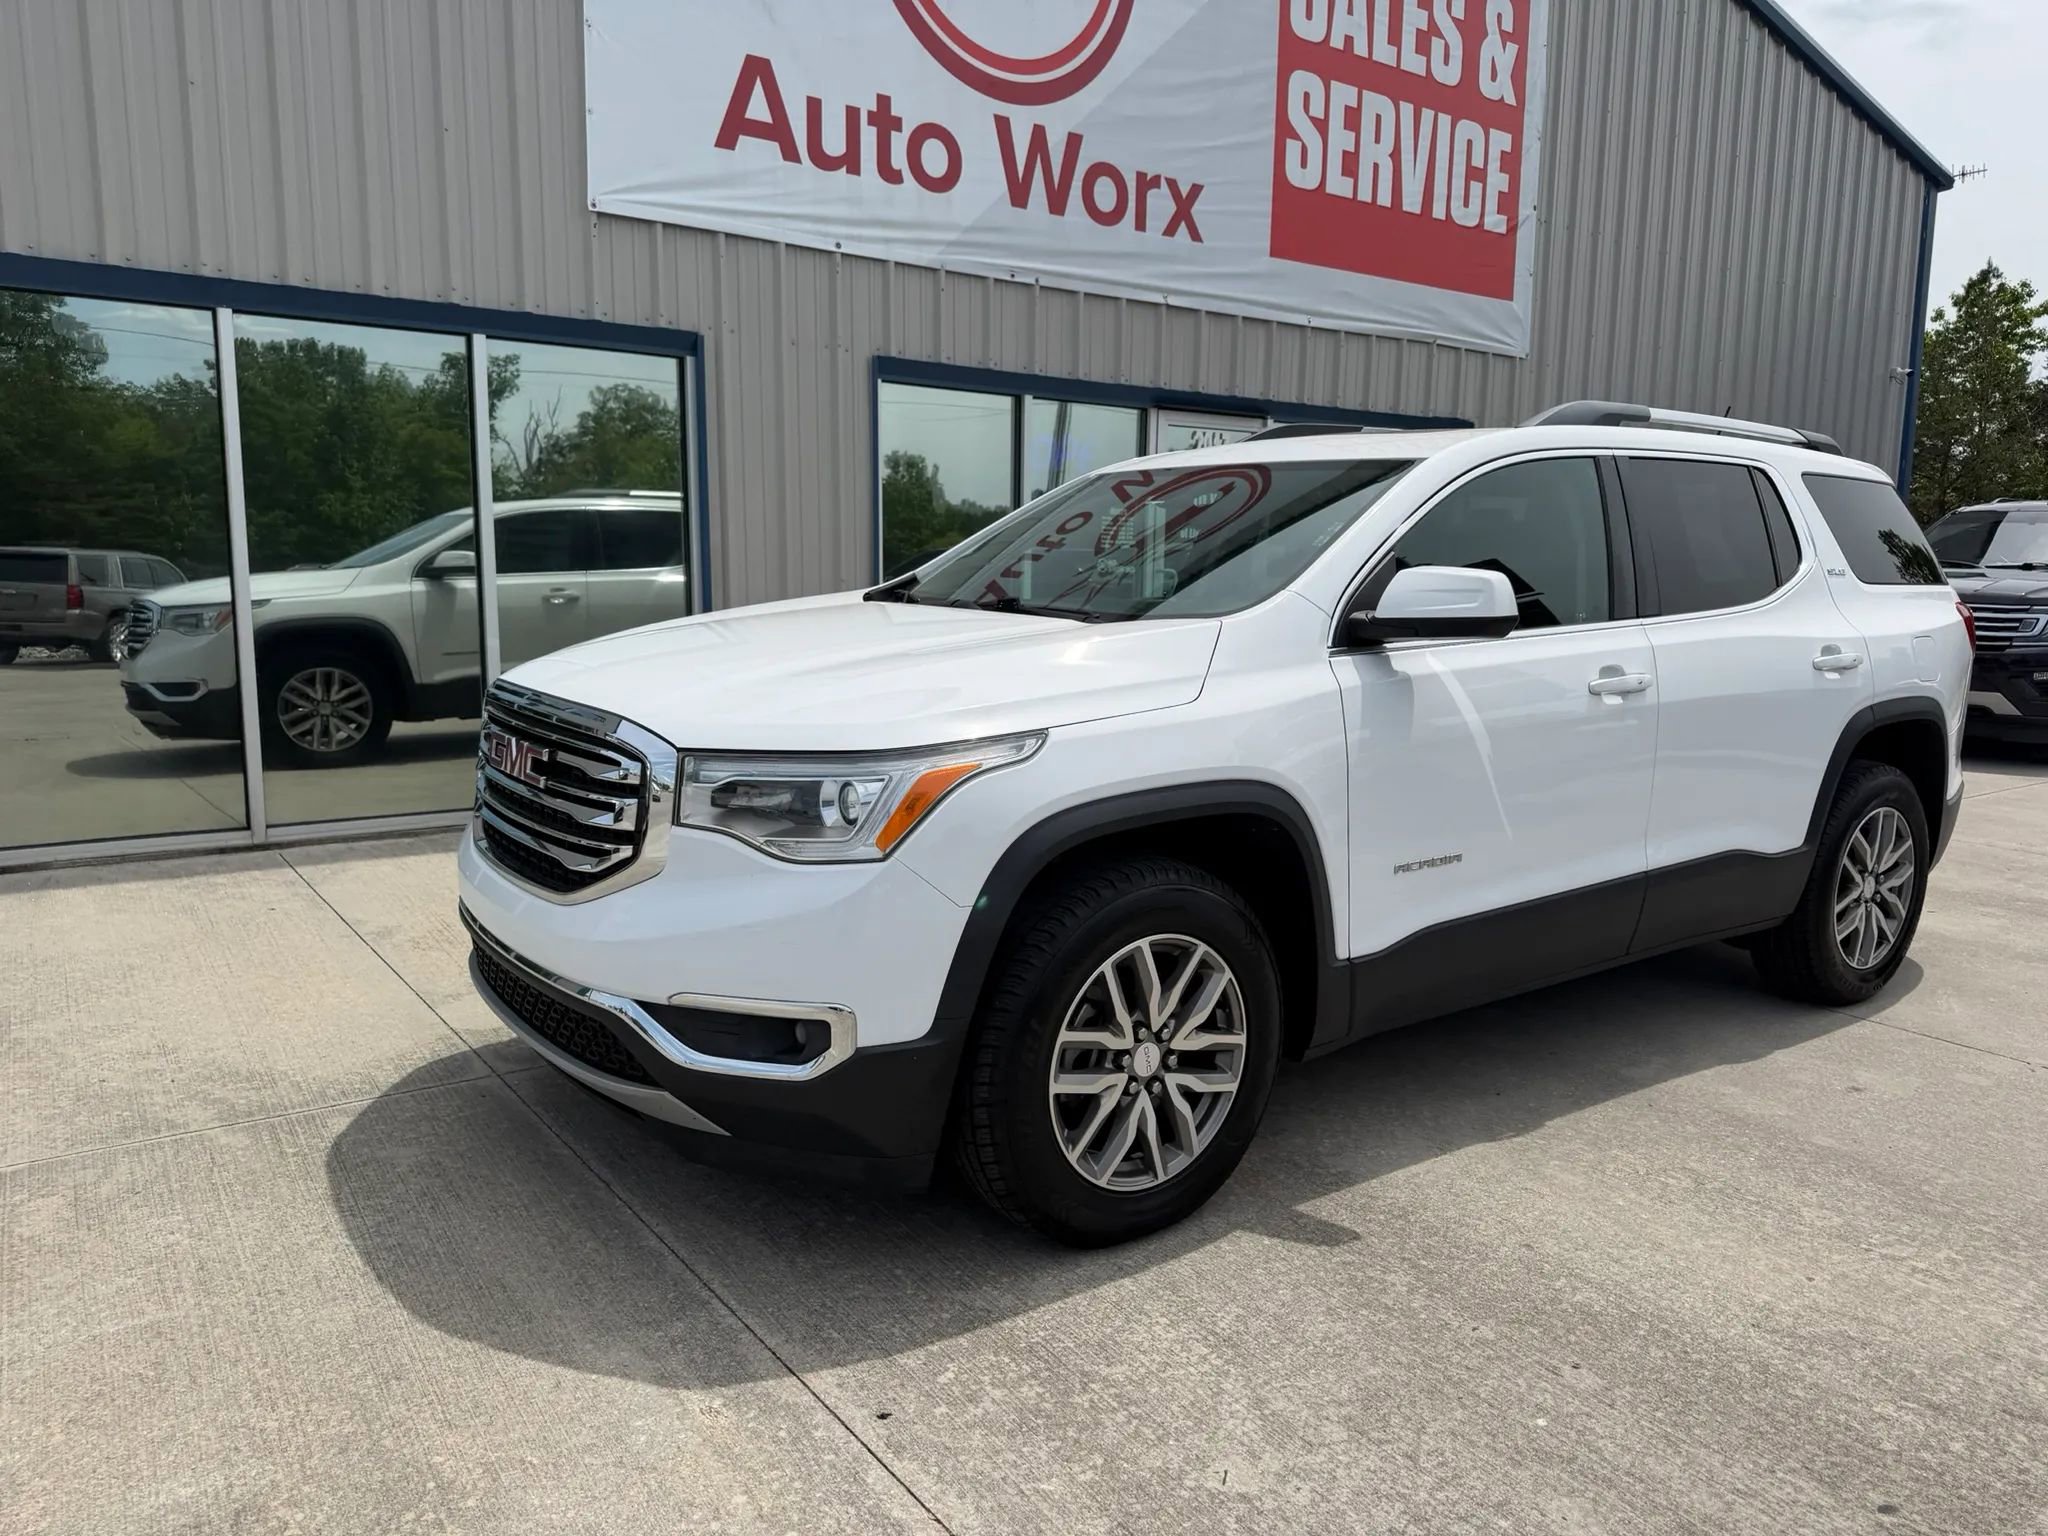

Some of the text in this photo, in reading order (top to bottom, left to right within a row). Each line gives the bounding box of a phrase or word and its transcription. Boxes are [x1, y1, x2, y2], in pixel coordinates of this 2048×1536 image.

[1478, 0, 1519, 106] &
[714, 53, 1204, 244] Auto Worx
[1285, 69, 1512, 234] SERVICE
[487, 732, 549, 789] GMC
[1143, 1046, 1152, 1073] GMC
